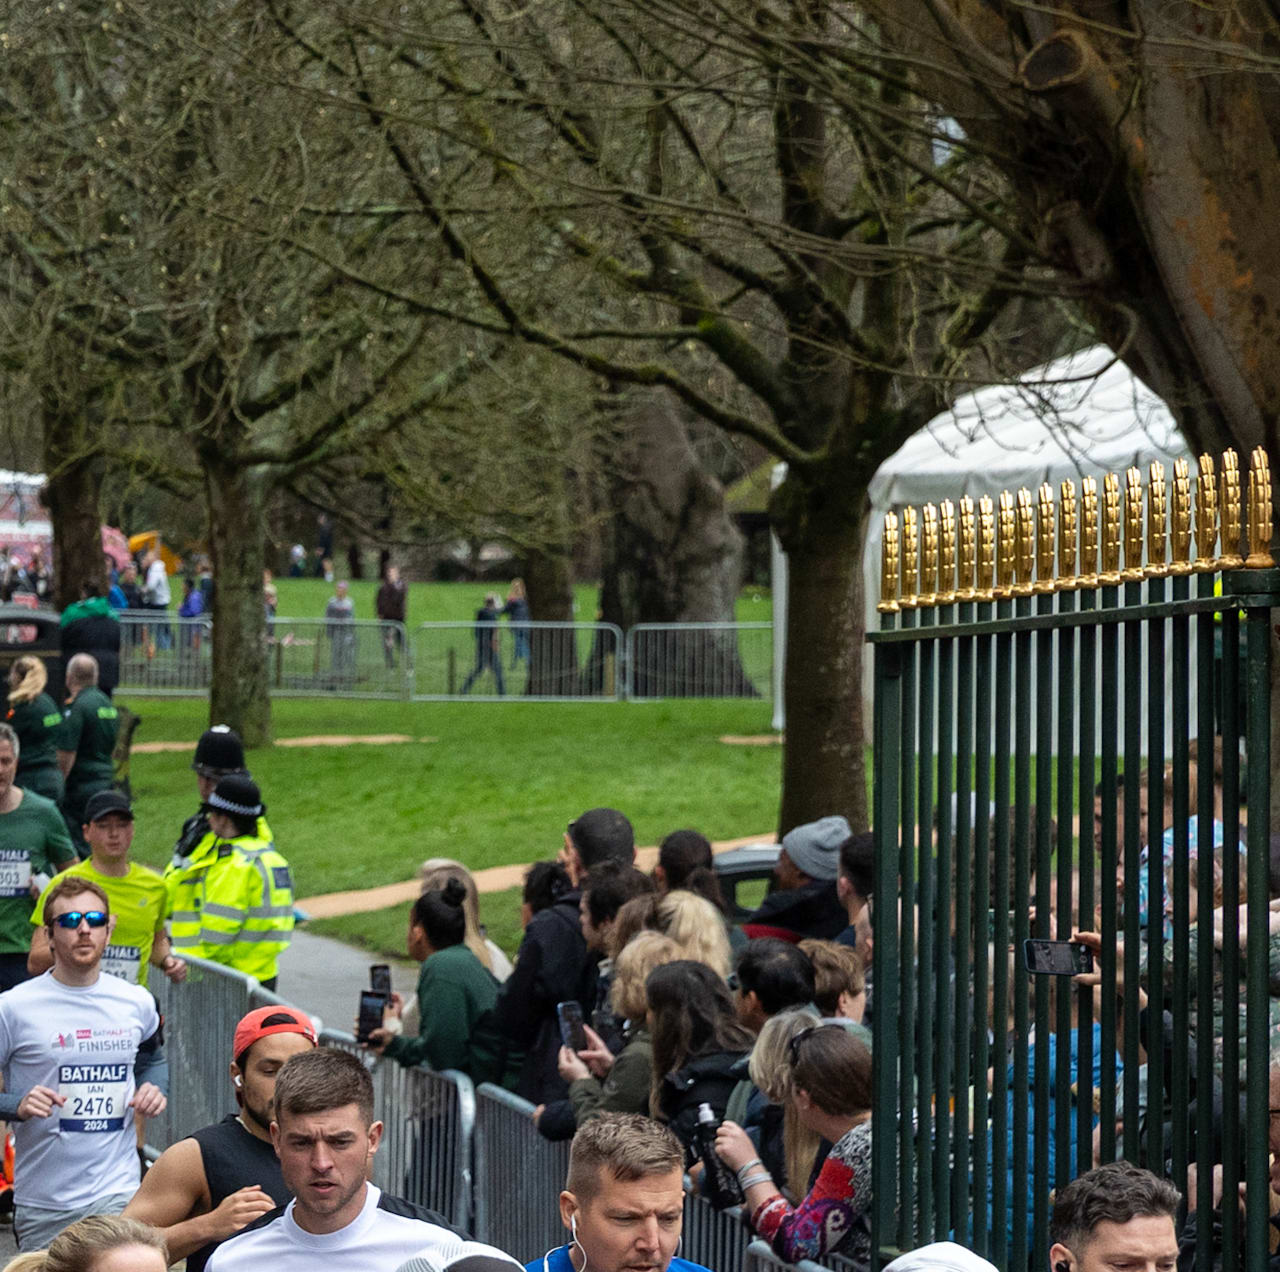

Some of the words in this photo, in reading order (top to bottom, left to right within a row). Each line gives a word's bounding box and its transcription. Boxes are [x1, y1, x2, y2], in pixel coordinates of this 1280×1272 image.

[104, 946, 139, 960] THALF
[79, 1040, 132, 1052] FINISHER
[61, 1065, 127, 1084] BATHALF
[87, 1084, 105, 1094] IAN
[73, 1097, 115, 1116] 2476
[84, 1120, 109, 1131] 2024
